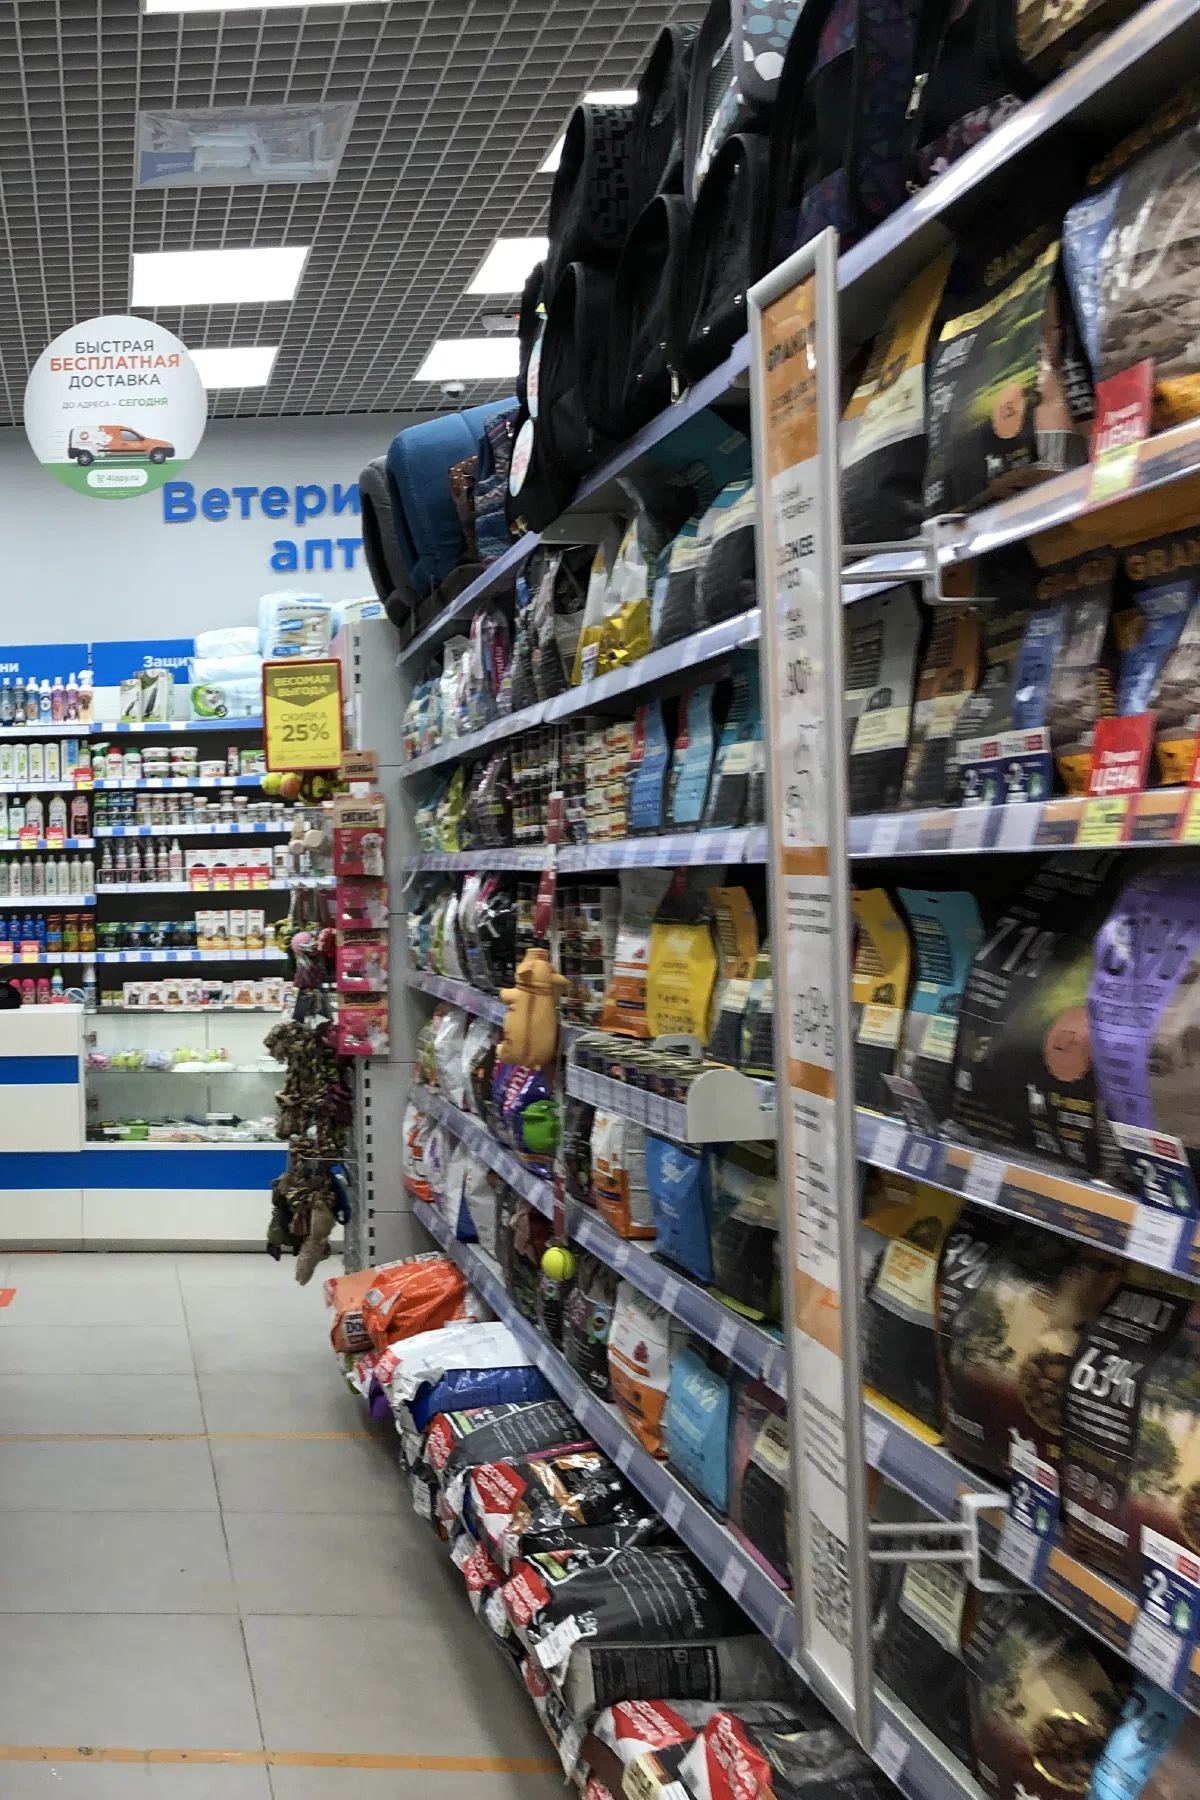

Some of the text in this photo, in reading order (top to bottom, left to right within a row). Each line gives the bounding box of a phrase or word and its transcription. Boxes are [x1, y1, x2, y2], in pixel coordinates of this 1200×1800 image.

[75, 340, 154, 354] БЫСТРАЯ
[50, 354, 180, 372] БЕСПЛАТНАЯ
[69, 374, 161, 390] ДОСТАВКА
[119, 398, 168, 408] СЕГОДНЯ
[274, 675, 330, 687] ВЕСОМАЯ
[277, 686, 328, 697] ВЫГОДА
[280, 712, 328, 722] СКИДКА
[281, 723, 330, 742] 25%
